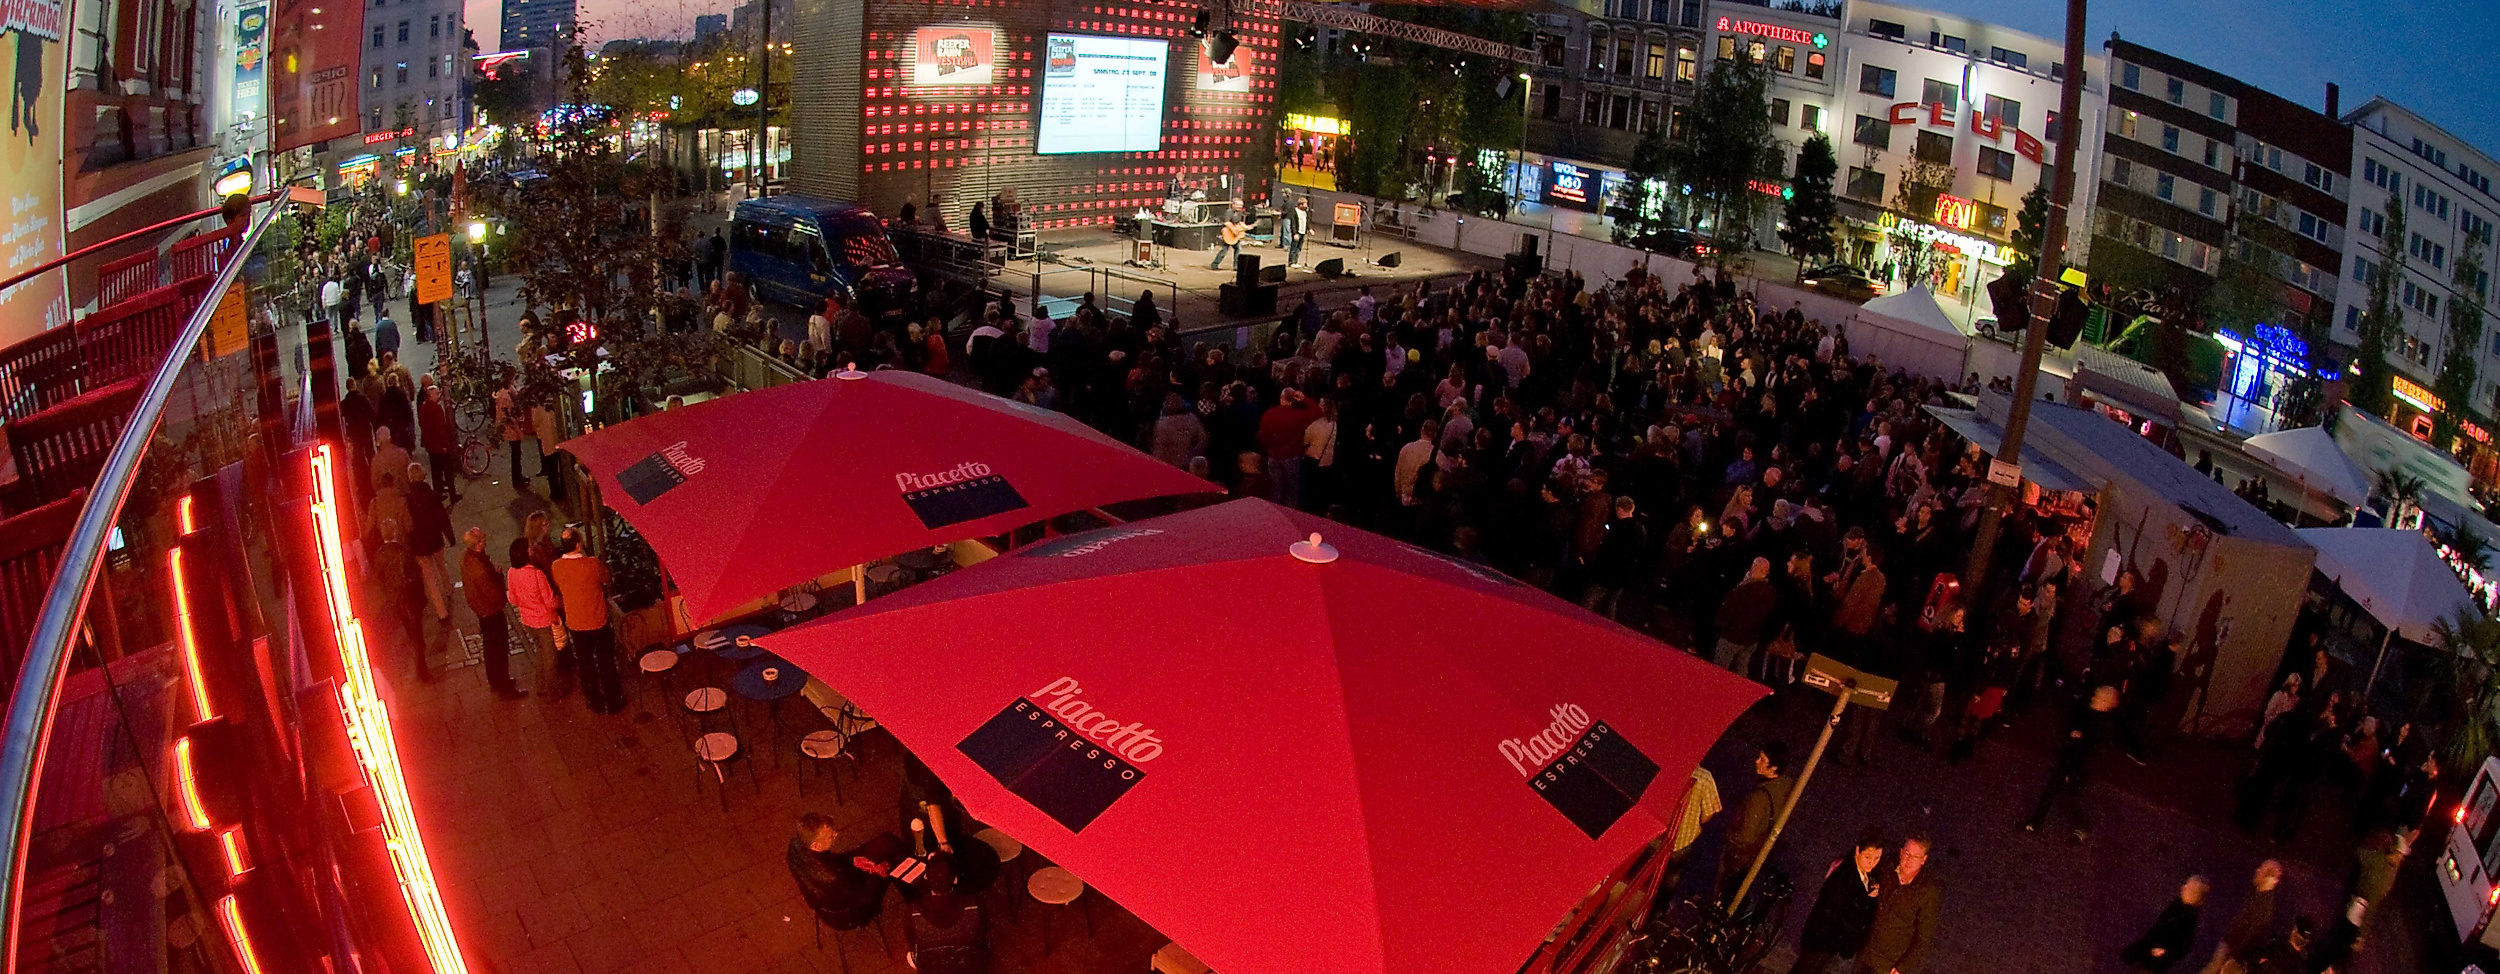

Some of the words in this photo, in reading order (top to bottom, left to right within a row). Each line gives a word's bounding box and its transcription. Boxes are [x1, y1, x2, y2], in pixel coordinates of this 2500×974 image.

[1732, 20, 1812, 45] APOTHEKE
[365, 131, 394, 144] BURGER
[1889, 101, 2044, 164] CLUB
[662, 441, 705, 475] Piacetto
[895, 461, 991, 492] Piacetto
[906, 476, 1001, 500] ESPRESSO
[1014, 701, 1135, 781] ESPRESSO
[1029, 676, 1164, 763] Piacetto
[1498, 702, 1590, 778] Piacetto
[1534, 724, 1608, 791] ESPRESSO
